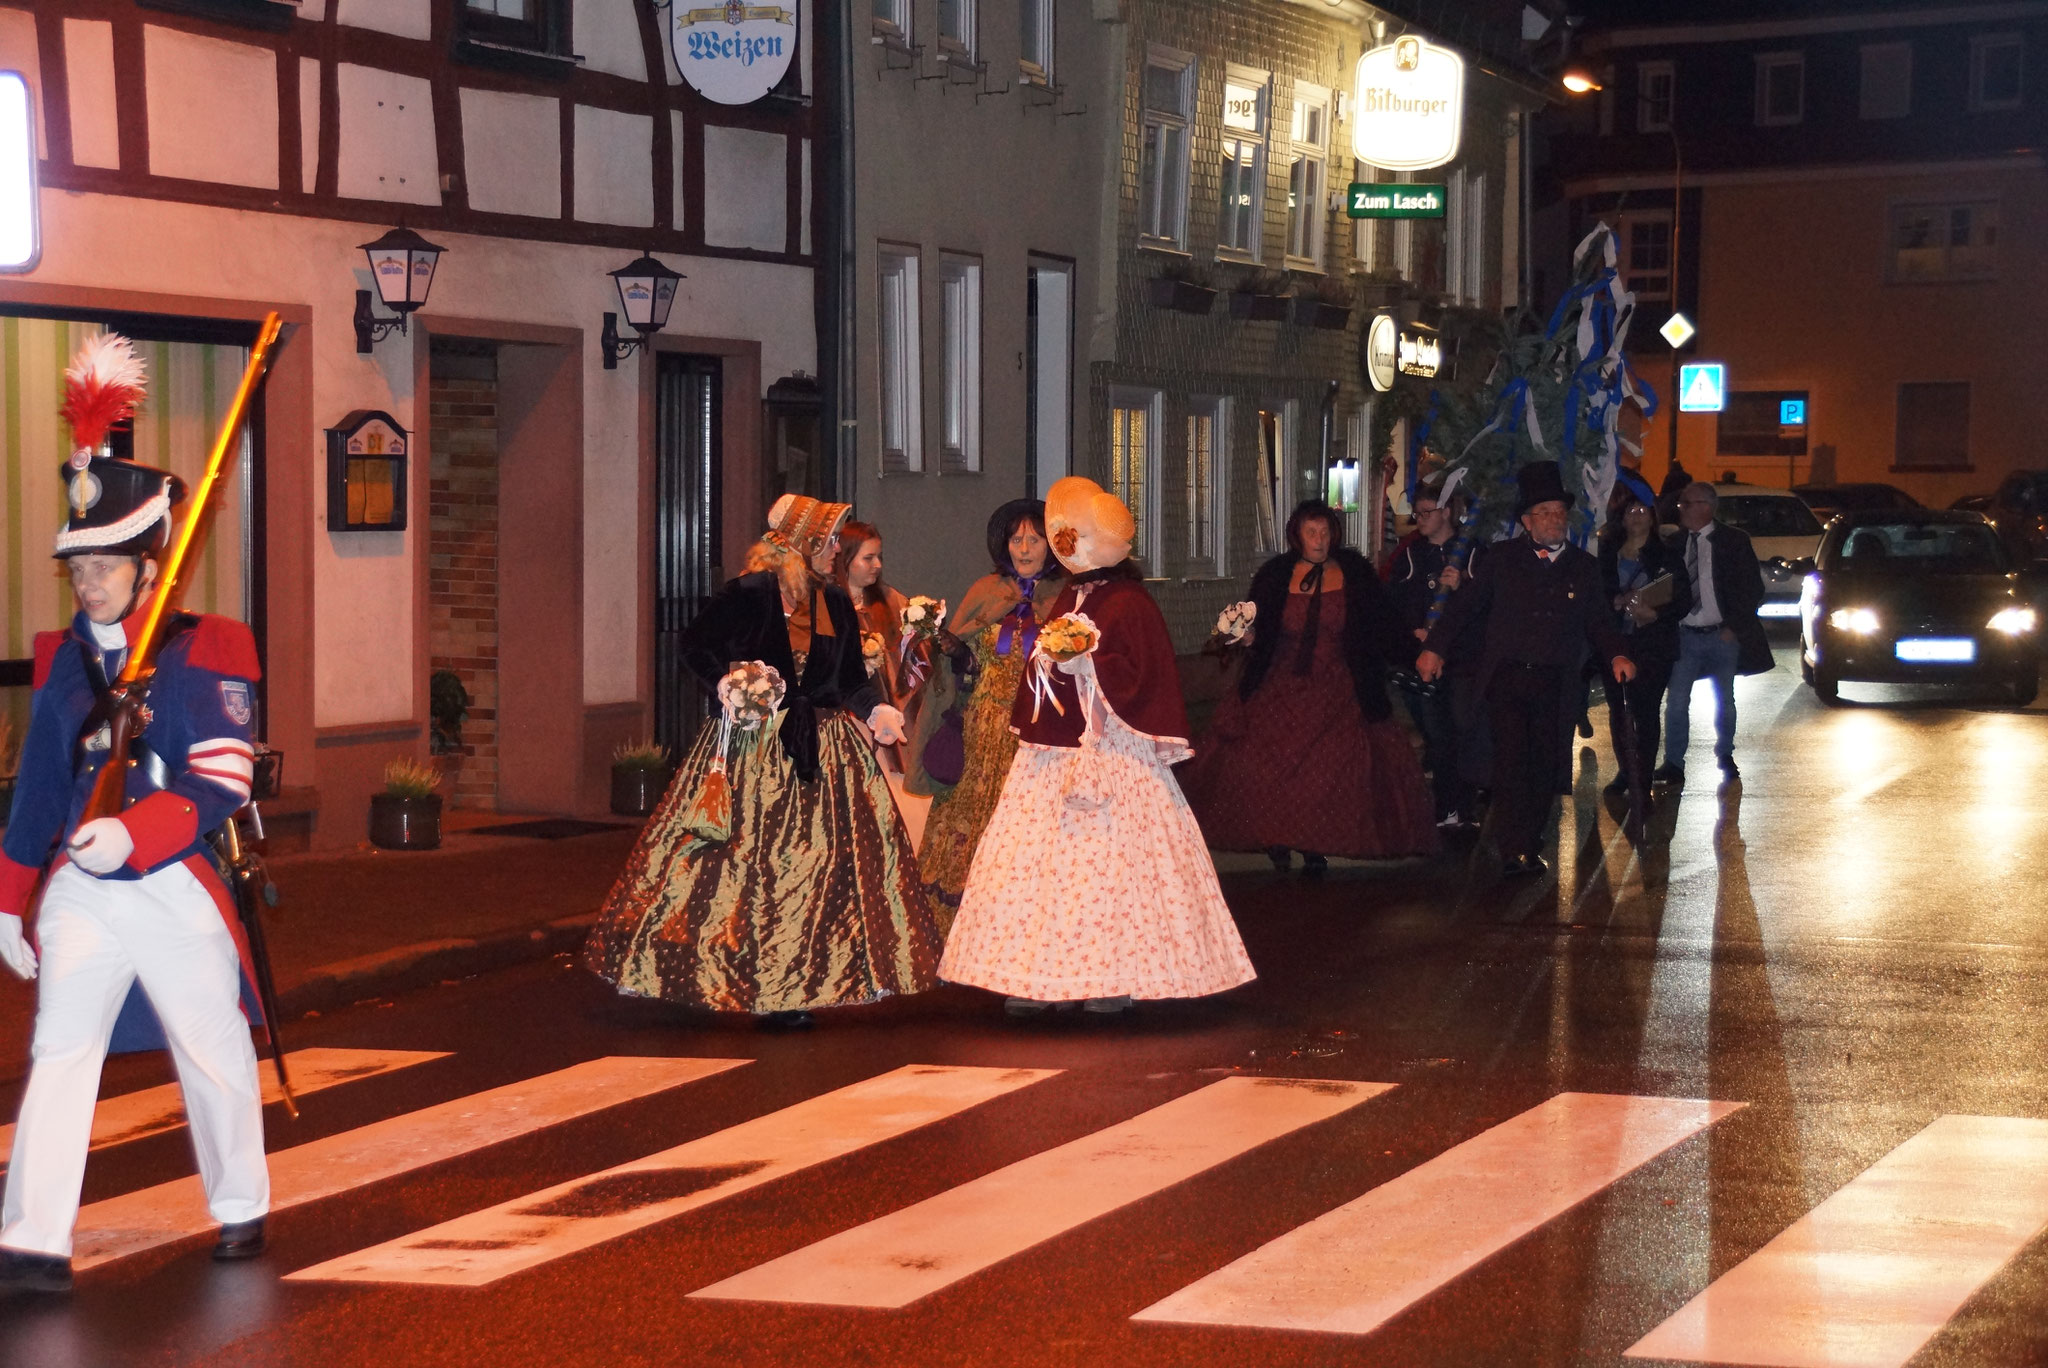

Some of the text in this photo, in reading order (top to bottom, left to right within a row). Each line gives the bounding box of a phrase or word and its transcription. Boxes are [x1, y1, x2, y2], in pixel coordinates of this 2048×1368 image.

[688, 31, 782, 67] Weizen
[1365, 87, 1448, 117] Bitburger
[1354, 192, 1437, 209] Zum Lasch
[1787, 404, 1797, 420] P
